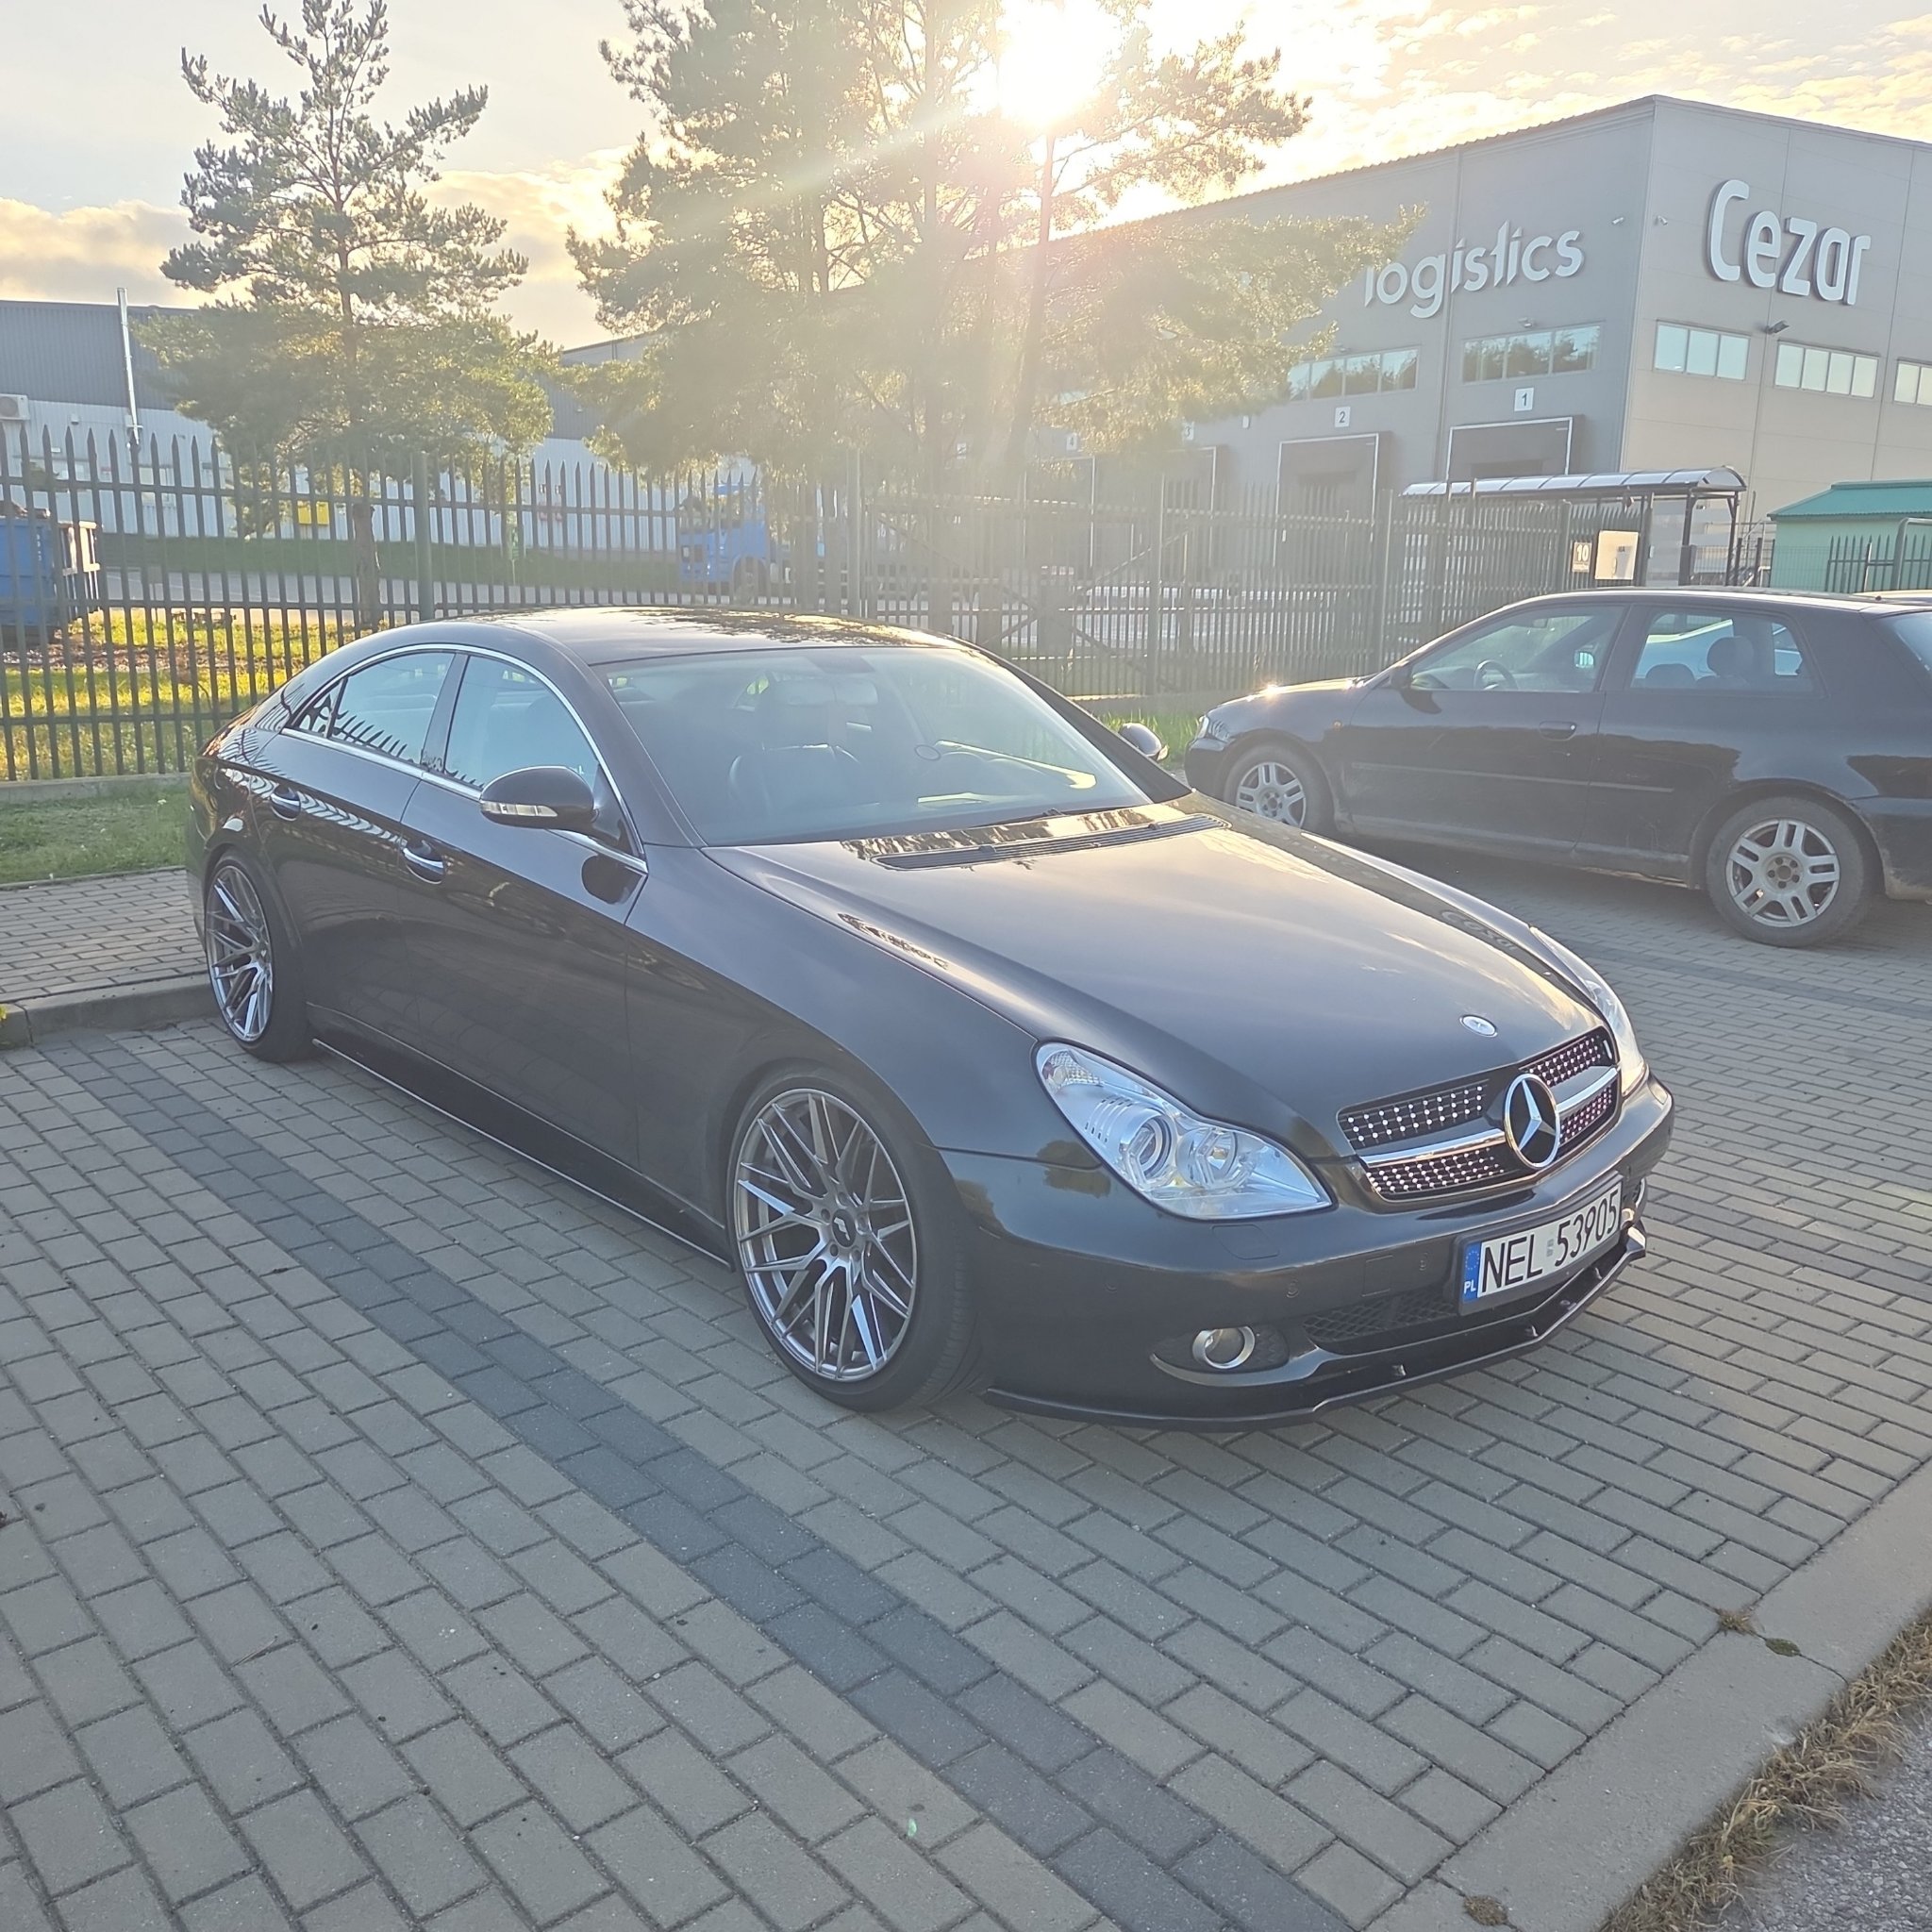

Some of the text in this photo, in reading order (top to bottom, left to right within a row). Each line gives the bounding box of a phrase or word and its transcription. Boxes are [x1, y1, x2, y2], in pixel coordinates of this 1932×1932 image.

[1365, 219, 1584, 319] logistics
[1708, 179, 1872, 305] Cezar
[1576, 543, 1590, 562] 10
[1464, 1280, 1476, 1295] PL
[1482, 1190, 1619, 1293] NEL 53905
